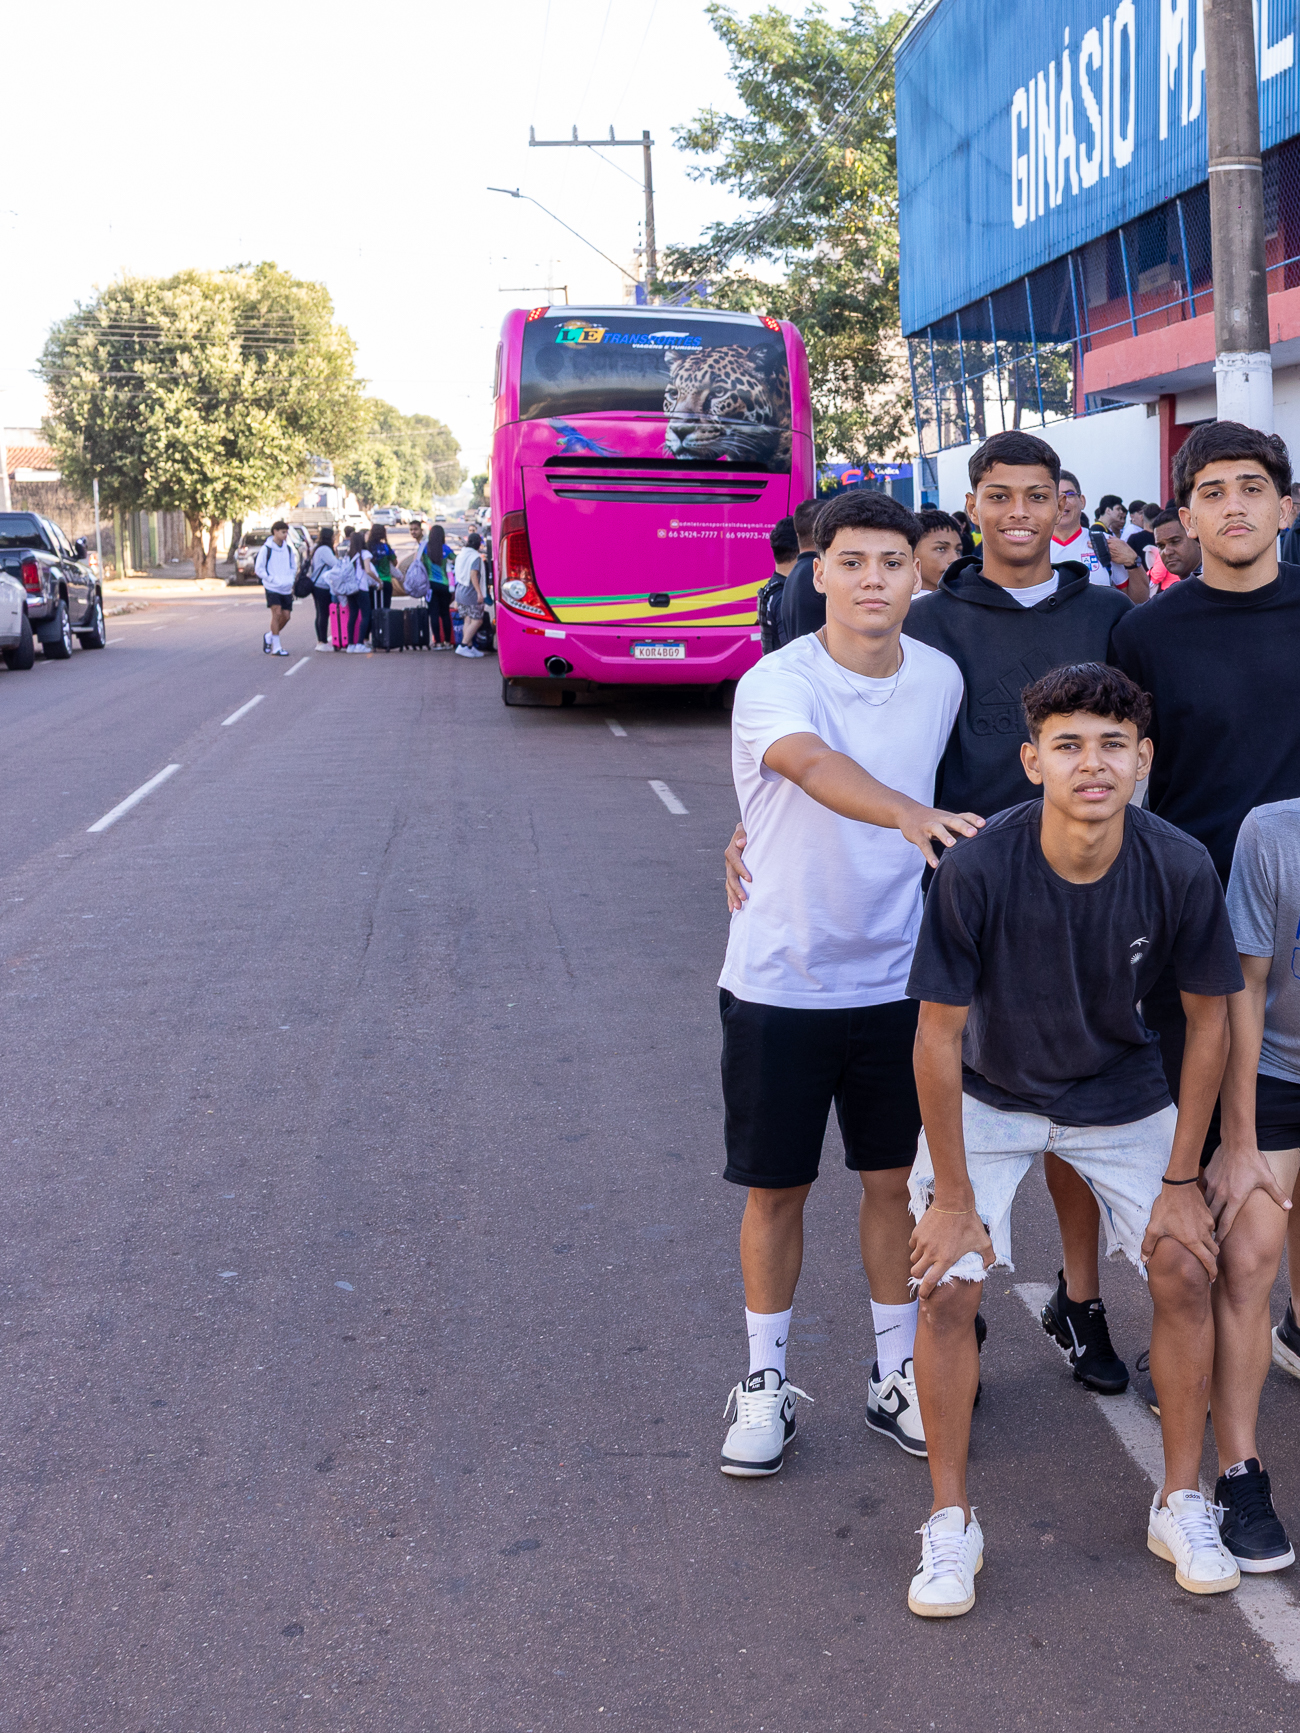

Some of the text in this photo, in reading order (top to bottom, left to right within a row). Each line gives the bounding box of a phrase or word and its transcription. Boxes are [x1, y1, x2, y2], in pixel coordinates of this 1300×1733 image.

[1011, 0, 1135, 229] GINÁSIO
[603, 333, 703, 346] TRANSPORTES
[680, 531, 718, 539] 3424-7777
[736, 532, 771, 540] 99973-78
